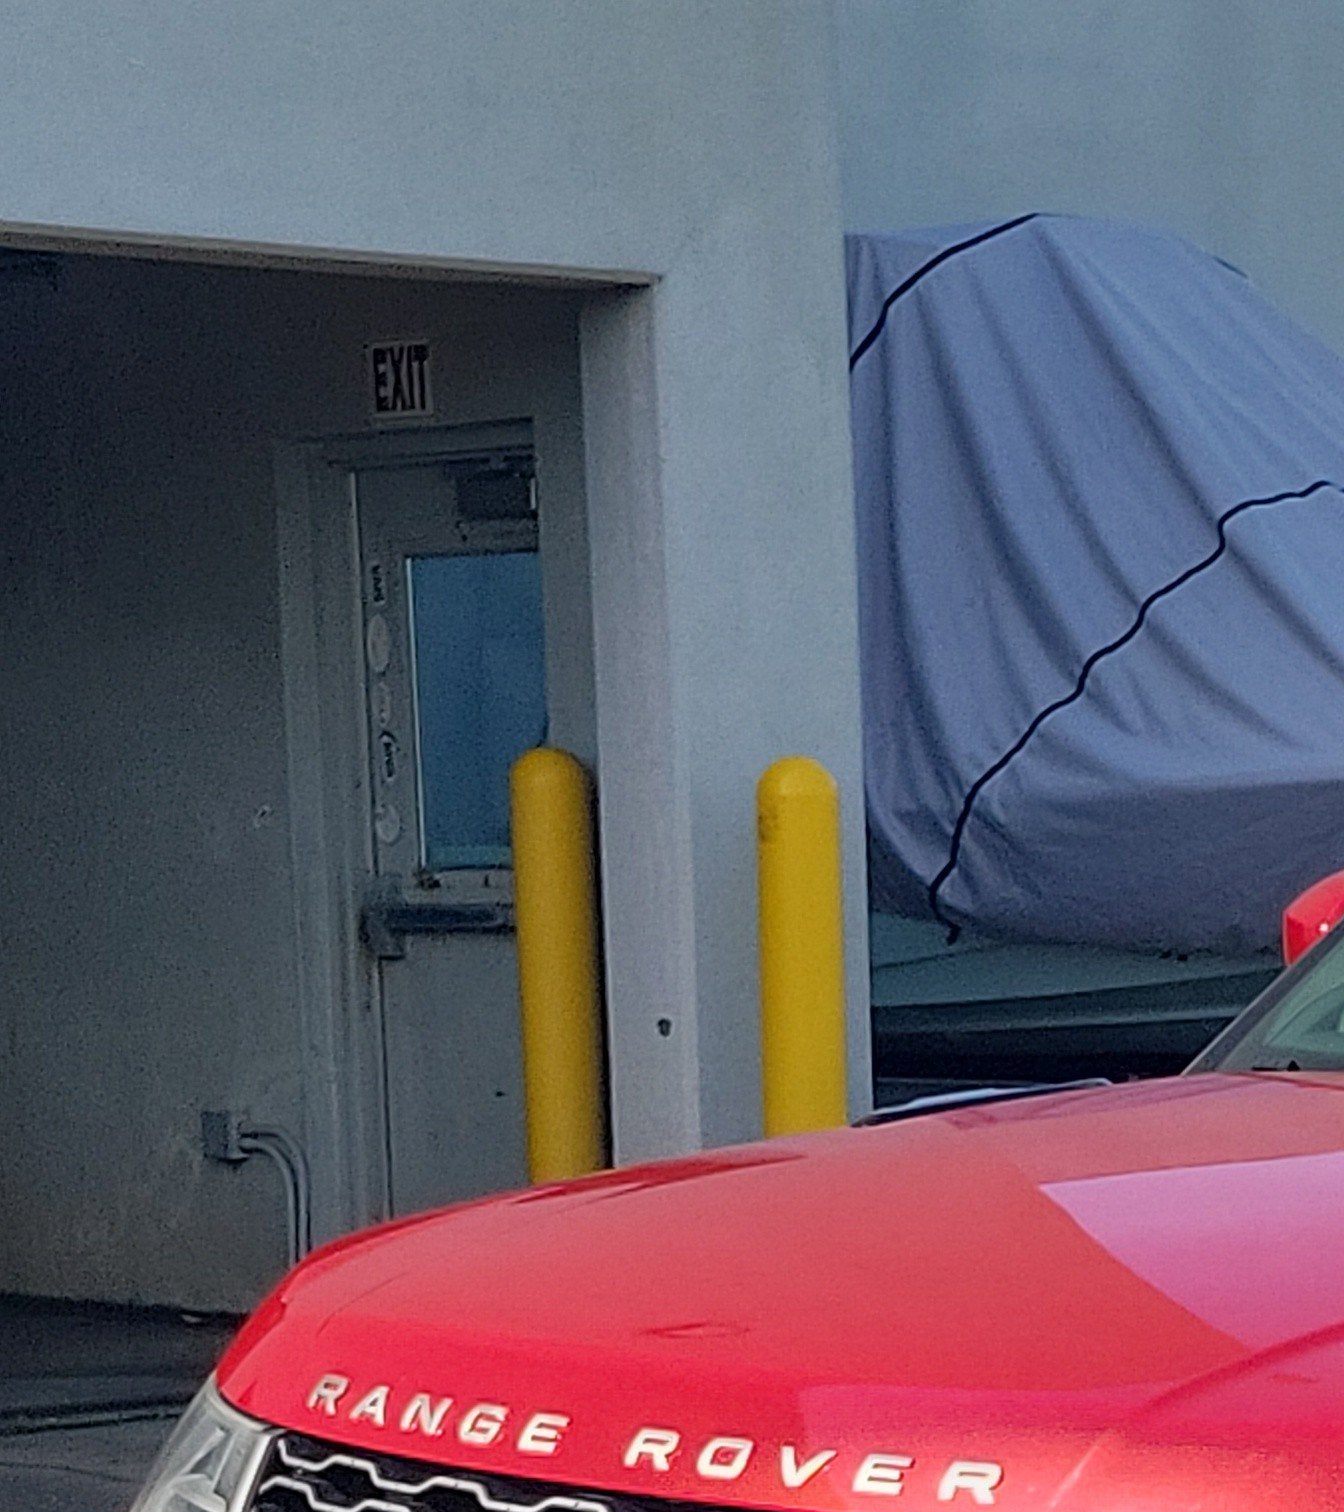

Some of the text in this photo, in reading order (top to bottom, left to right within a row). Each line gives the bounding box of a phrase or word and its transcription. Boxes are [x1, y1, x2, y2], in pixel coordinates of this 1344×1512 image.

[373, 344, 428, 412] EXIT
[307, 1373, 1002, 1505] RANGE ROVER
